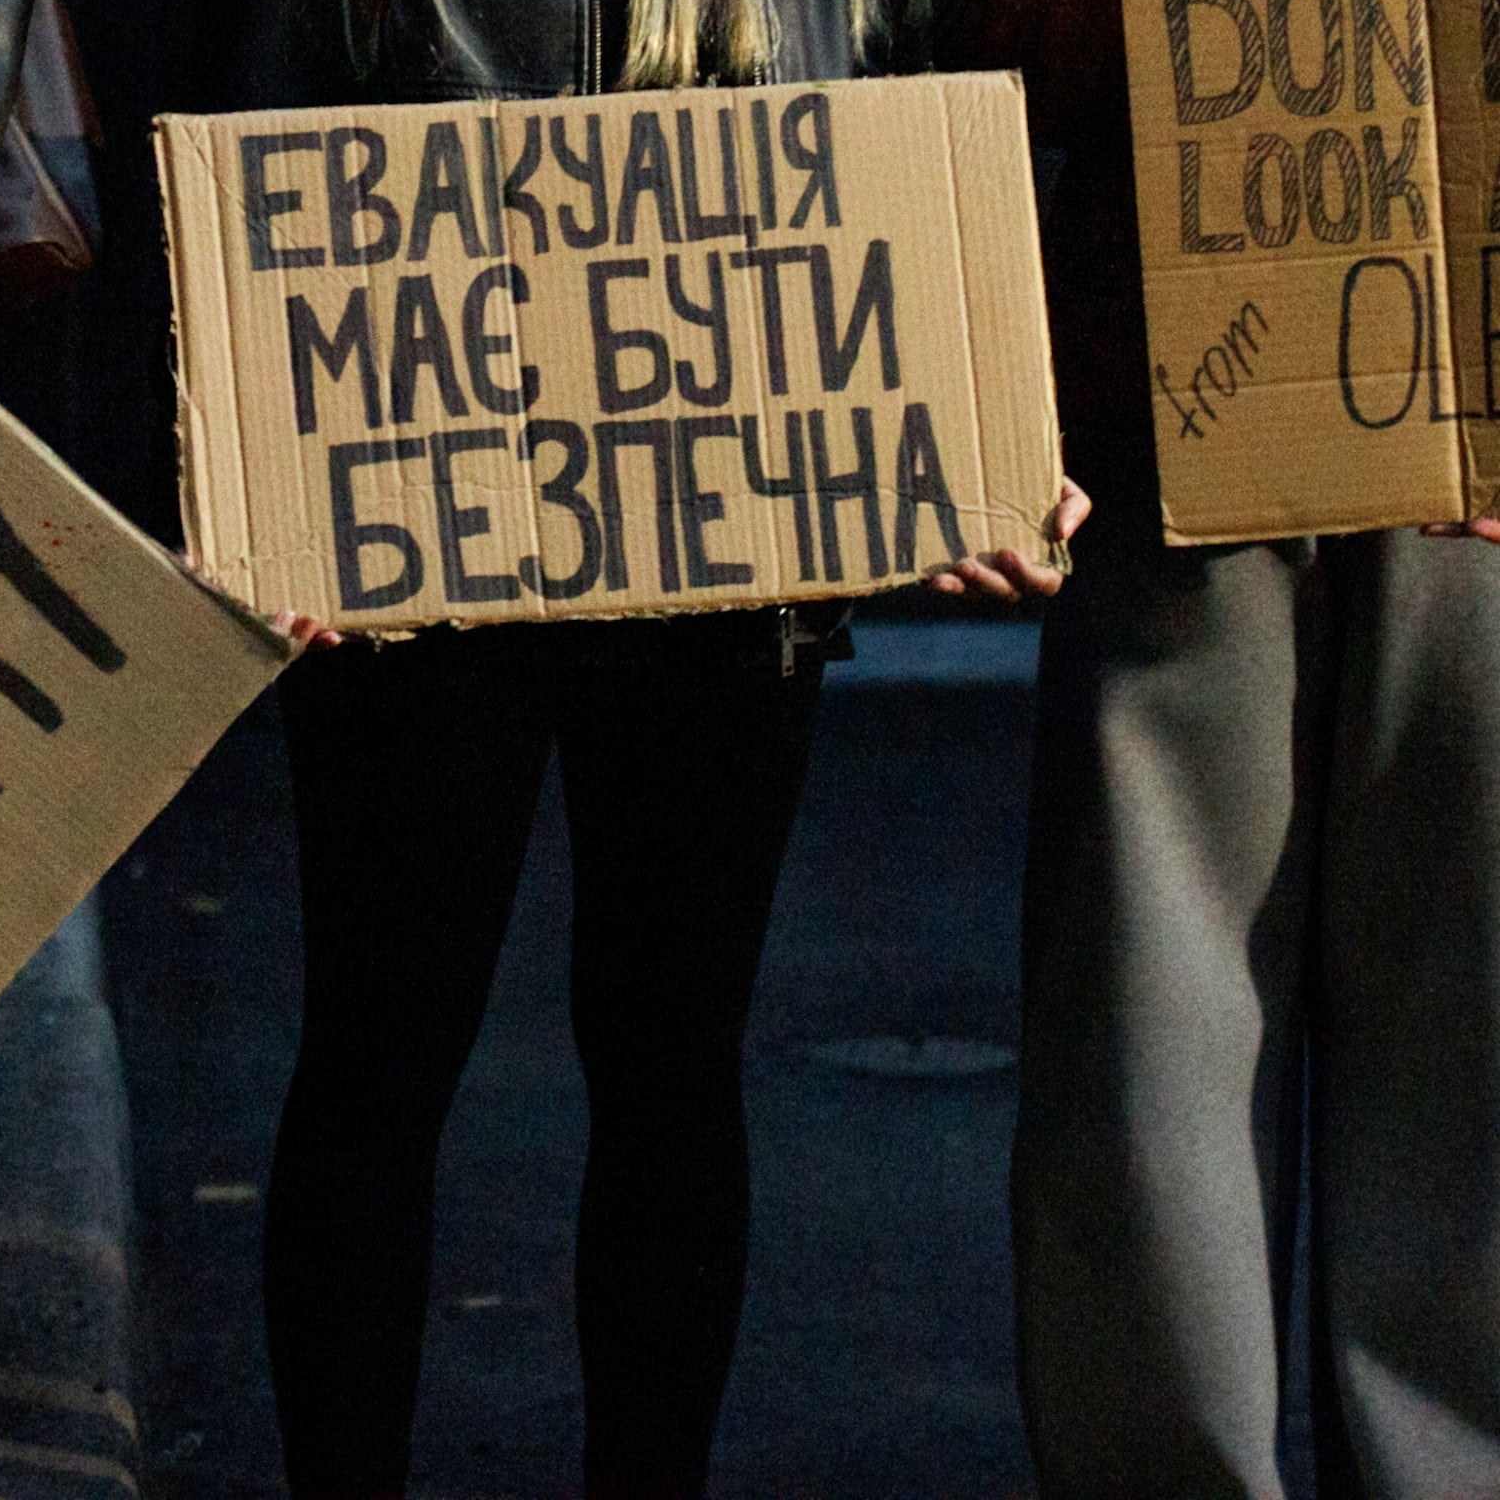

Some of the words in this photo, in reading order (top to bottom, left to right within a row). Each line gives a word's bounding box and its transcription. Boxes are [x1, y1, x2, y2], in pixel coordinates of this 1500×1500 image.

[239, 92, 842, 271] ЕВАКУАЦІЯ
[1177, 118, 1430, 254] LOOK
[285, 262, 539, 435] МАЄ
[587, 239, 902, 414] БУТИ
[1155, 300, 1270, 440] from
[327, 401, 968, 612] БЕЗПЕЧНА
